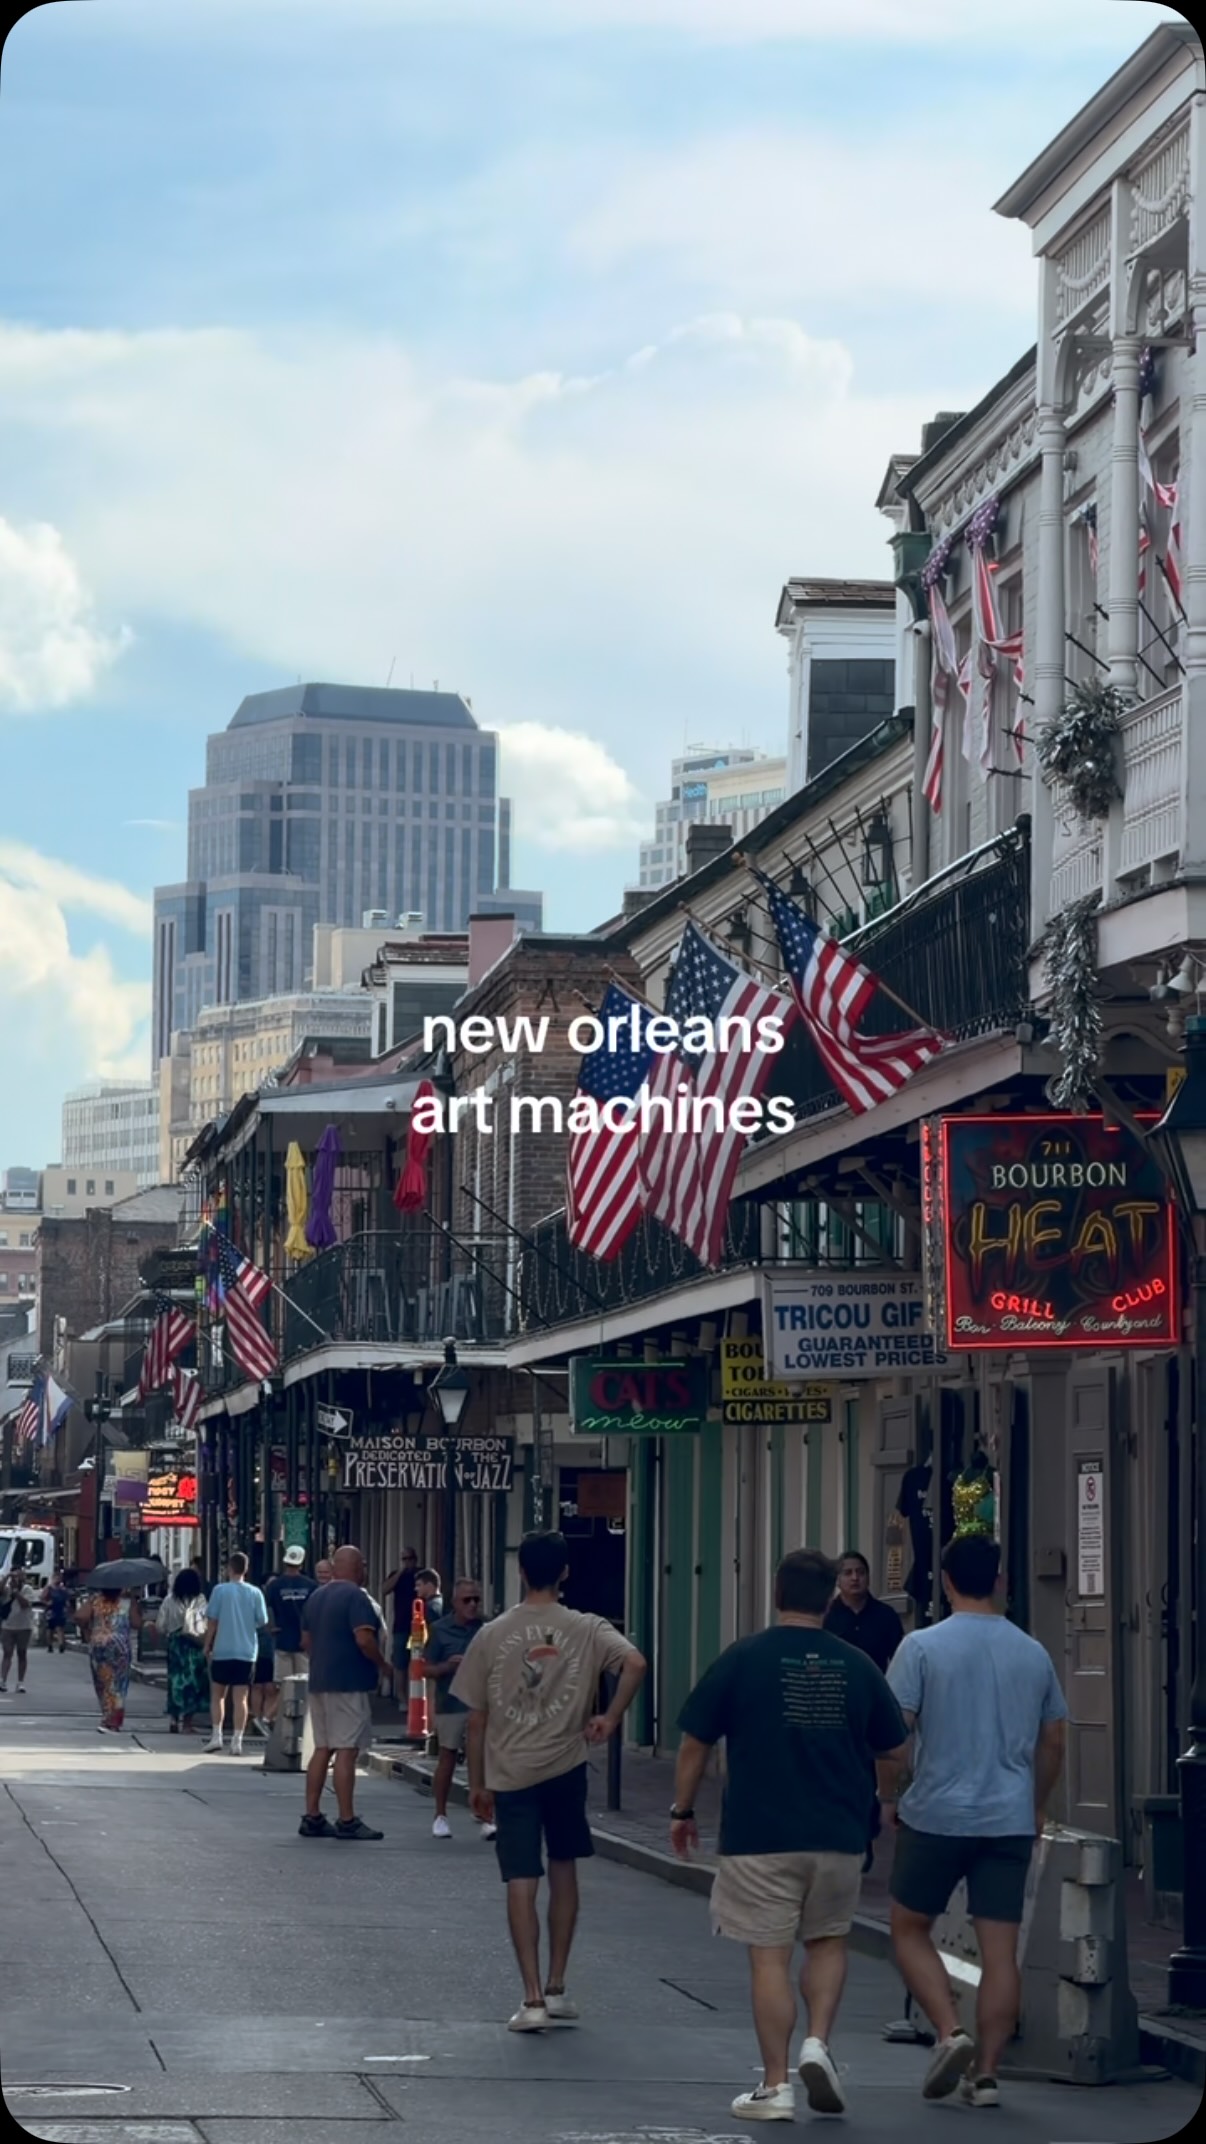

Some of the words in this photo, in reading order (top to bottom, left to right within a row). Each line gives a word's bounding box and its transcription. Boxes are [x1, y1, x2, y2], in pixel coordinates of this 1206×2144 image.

[1042, 1141, 1070, 1156] 711
[991, 1162, 1127, 1189] BOURBON
[969, 1199, 1160, 1299] HEAT
[811, 1284, 833, 1297] 709
[838, 1283, 895, 1296] BOURBON
[900, 1282, 918, 1294] ST.
[991, 1292, 1055, 1319] GRILL
[1111, 1278, 1166, 1312] CLUB
[774, 1302, 870, 1331] TRICOU
[798, 1334, 934, 1353] GUARANTEED
[785, 1352, 867, 1370] LOWEST
[875, 1350, 948, 1366] PRICES
[588, 1369, 691, 1411] CATS
[580, 1413, 699, 1430] meow
[725, 1401, 828, 1422] CIGARETTES
[350, 1435, 416, 1450] MAISON
[362, 1450, 432, 1462] DEDICATED
[471, 1451, 499, 1463] THE
[471, 1455, 512, 1490] JAZZ
